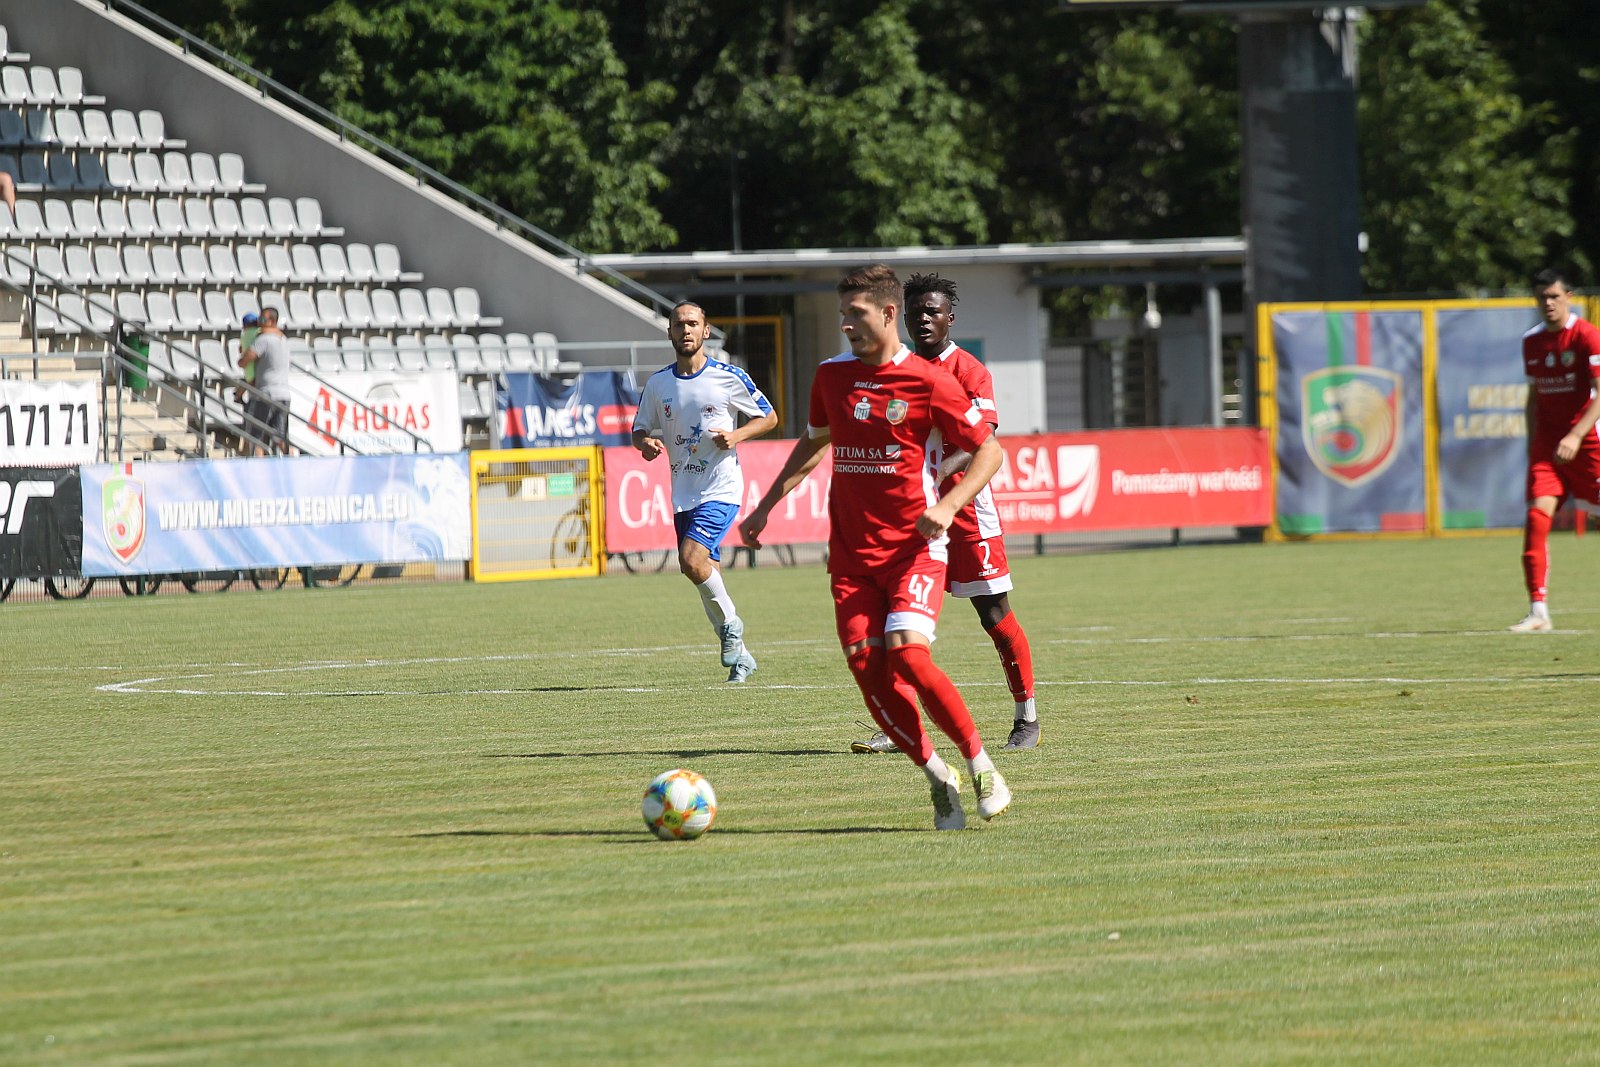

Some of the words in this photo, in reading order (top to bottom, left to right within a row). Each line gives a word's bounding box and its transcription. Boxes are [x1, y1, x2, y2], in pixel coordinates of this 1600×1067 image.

[833, 446, 865, 459] OTUM
[868, 448, 882, 459] SA
[1016, 446, 1055, 491] SA
[159, 494, 408, 532] WWW.MIEDZLEGNICA.EU
[978, 541, 993, 570] 2
[908, 573, 935, 605] 47
